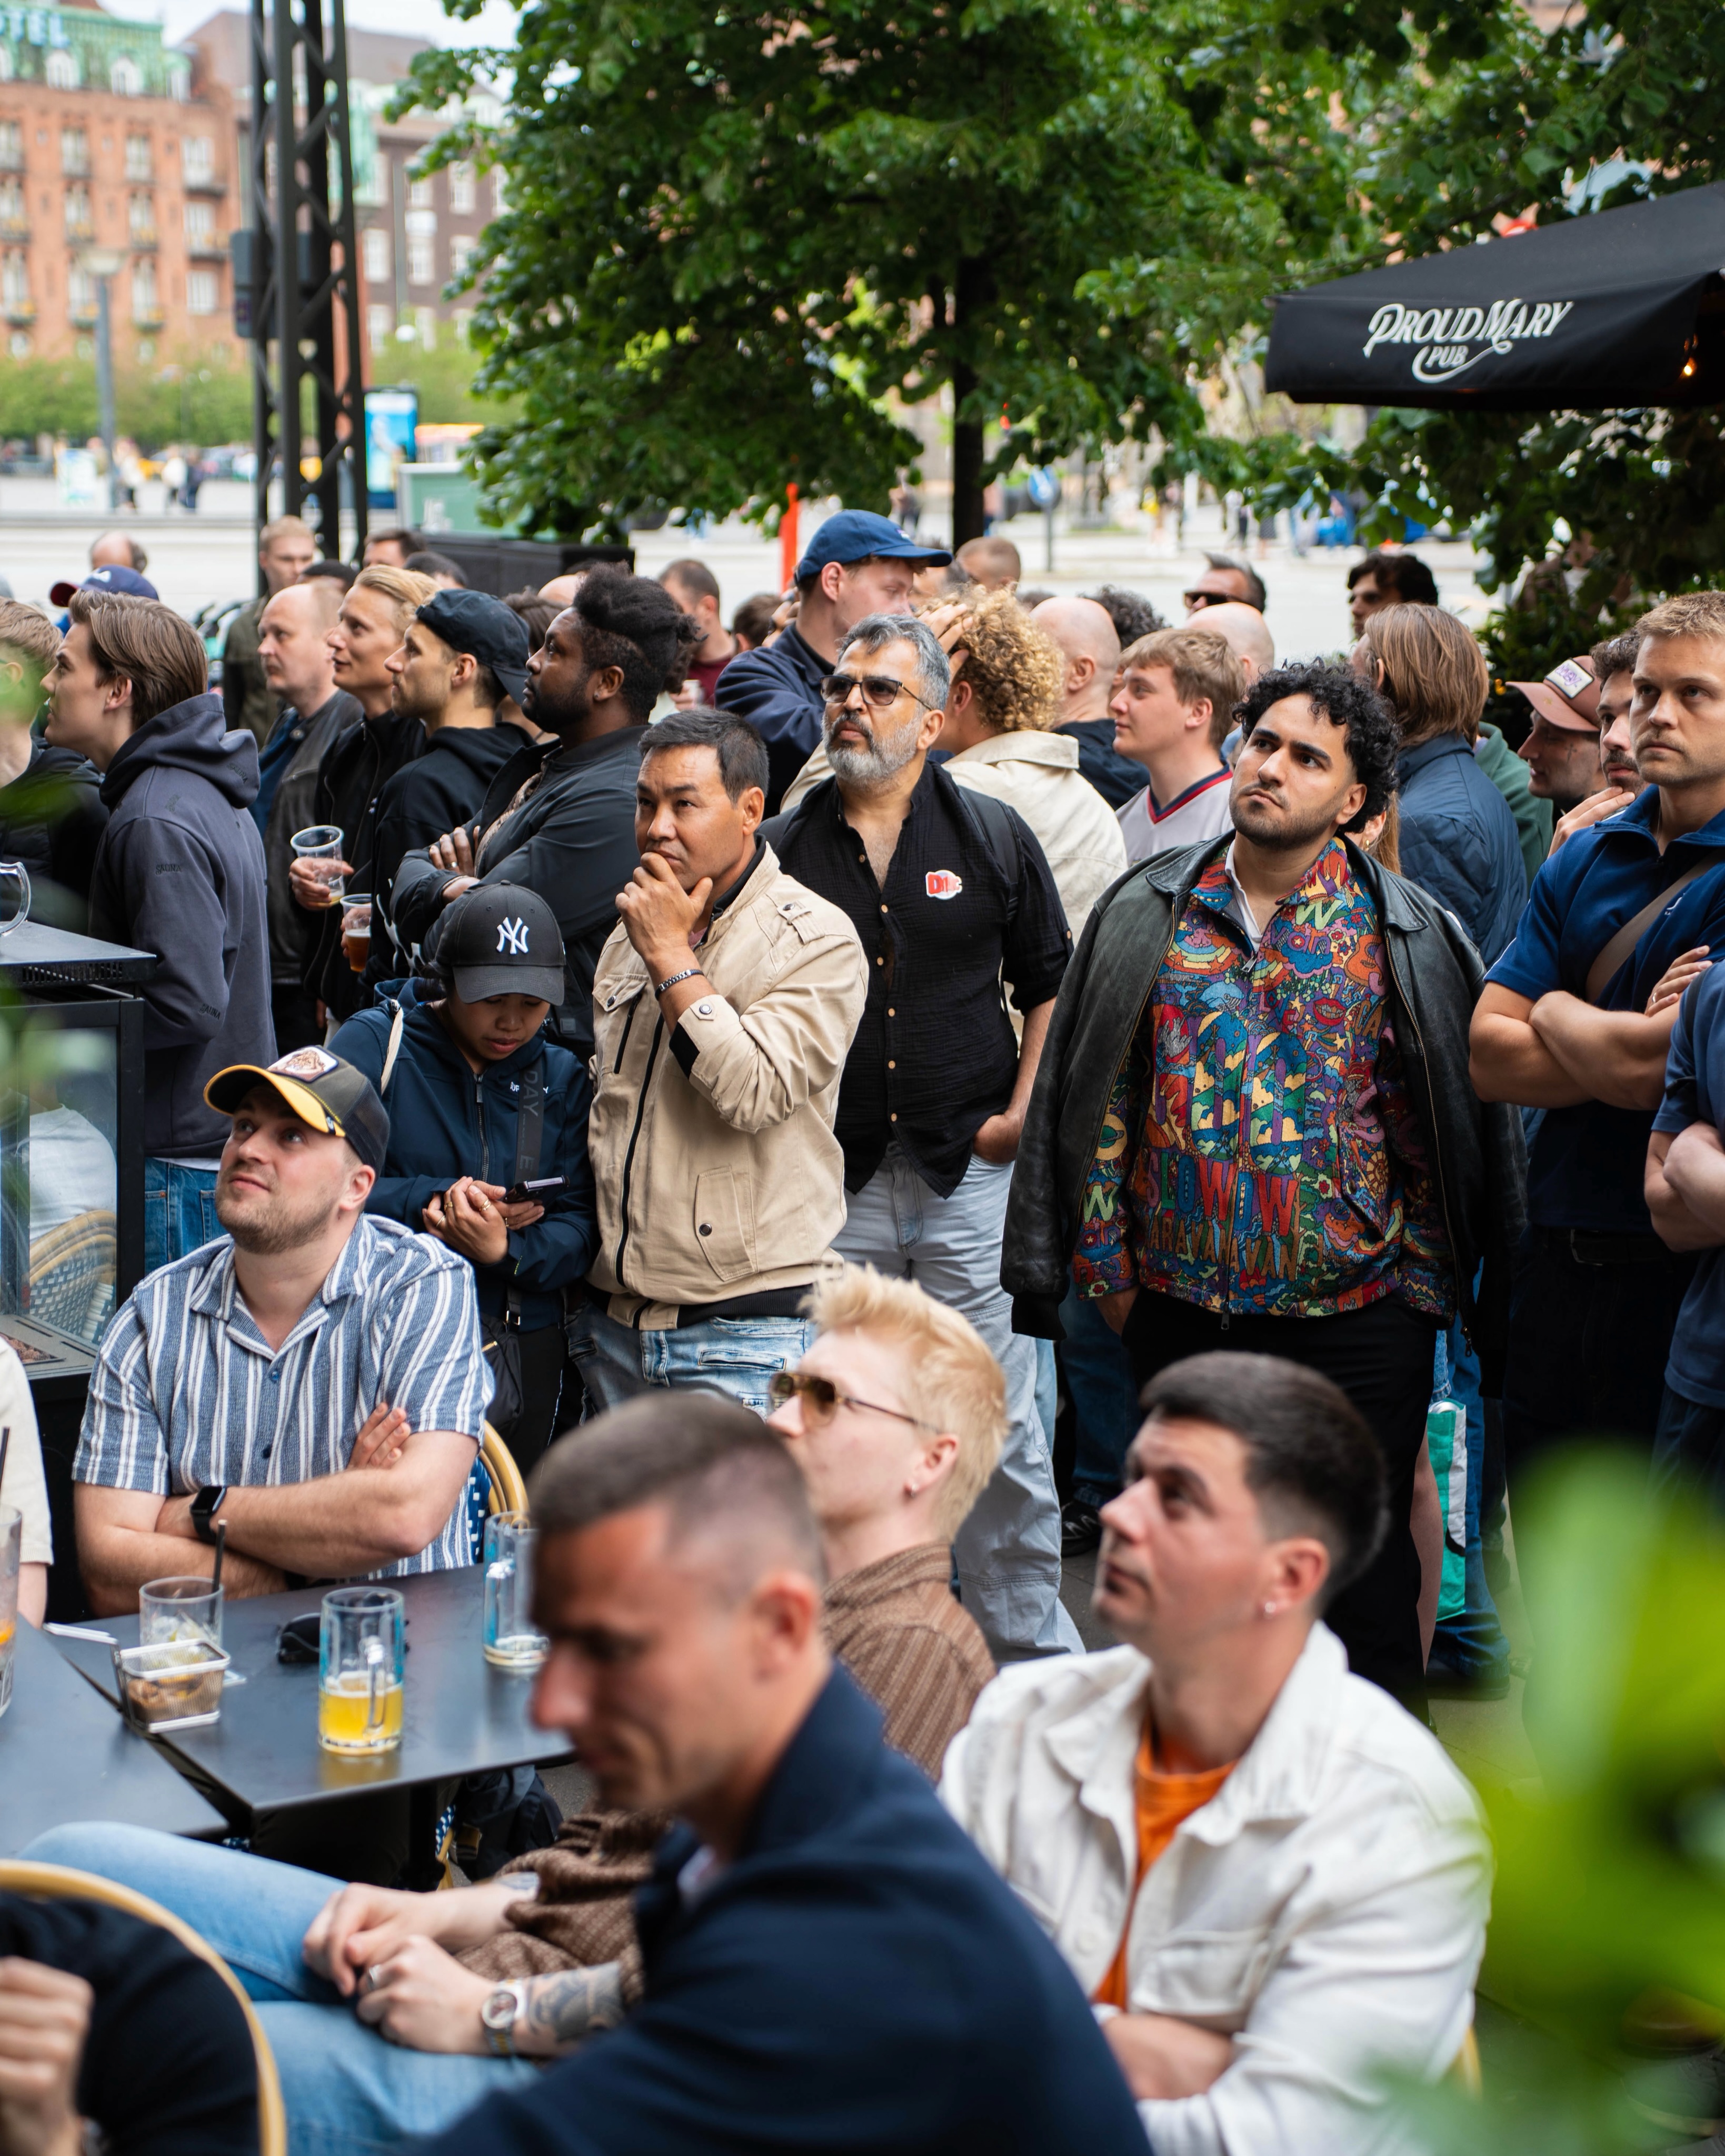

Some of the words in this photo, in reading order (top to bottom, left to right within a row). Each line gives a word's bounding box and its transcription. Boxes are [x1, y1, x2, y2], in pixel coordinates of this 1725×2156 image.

[1424, 345, 1469, 368] PUB
[155, 864, 182, 875] SAUNA
[496, 916, 529, 954] NY
[1146, 1152, 1238, 1222] SLOW
